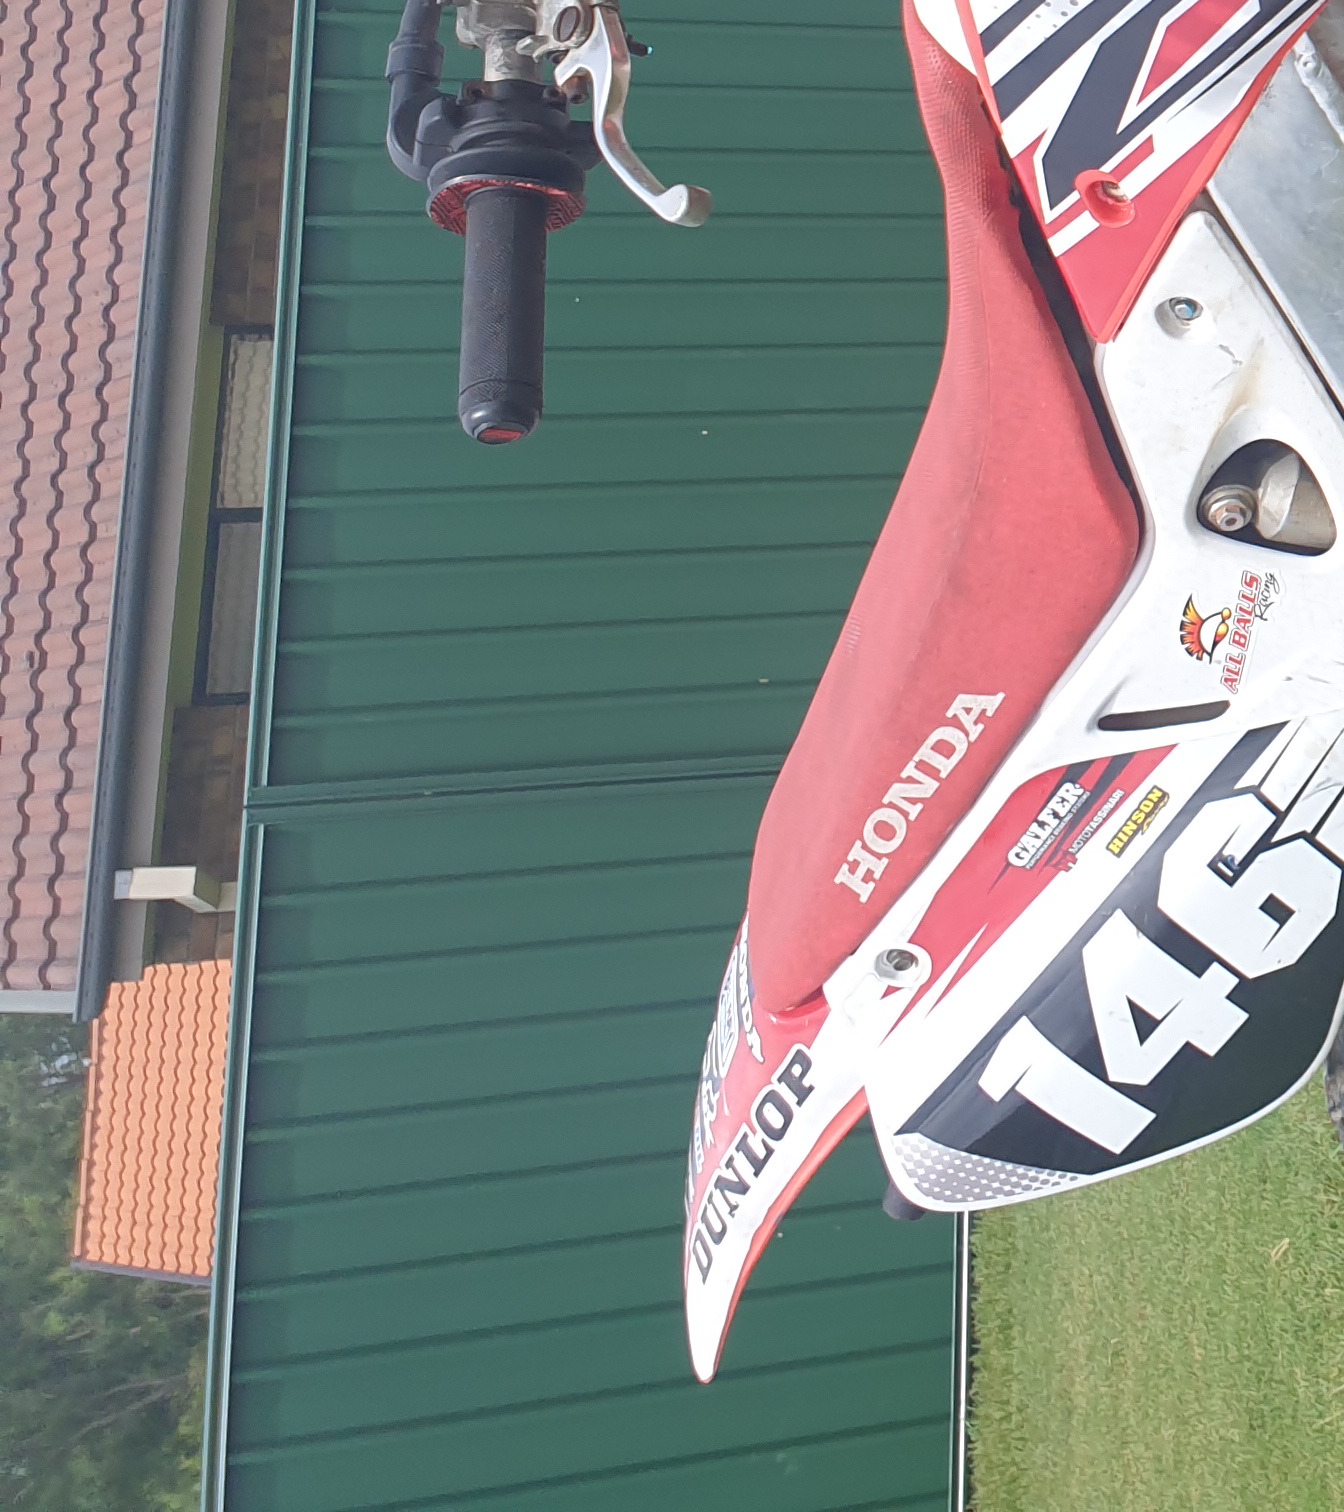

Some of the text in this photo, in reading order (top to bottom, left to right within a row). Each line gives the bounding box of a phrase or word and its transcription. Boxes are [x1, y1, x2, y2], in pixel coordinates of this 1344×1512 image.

[1220, 570, 1262, 694] ALL BALLS
[1253, 571, 1280, 622] Racing
[833, 691, 1006, 904] HONDA
[1007, 781, 1085, 867] GALFER
[1068, 788, 1125, 854] MOTOTASSINARI
[1108, 787, 1163, 855] HINSON
[977, 786, 1344, 1156] 146
[691, 1047, 816, 1285] DUNLOP
